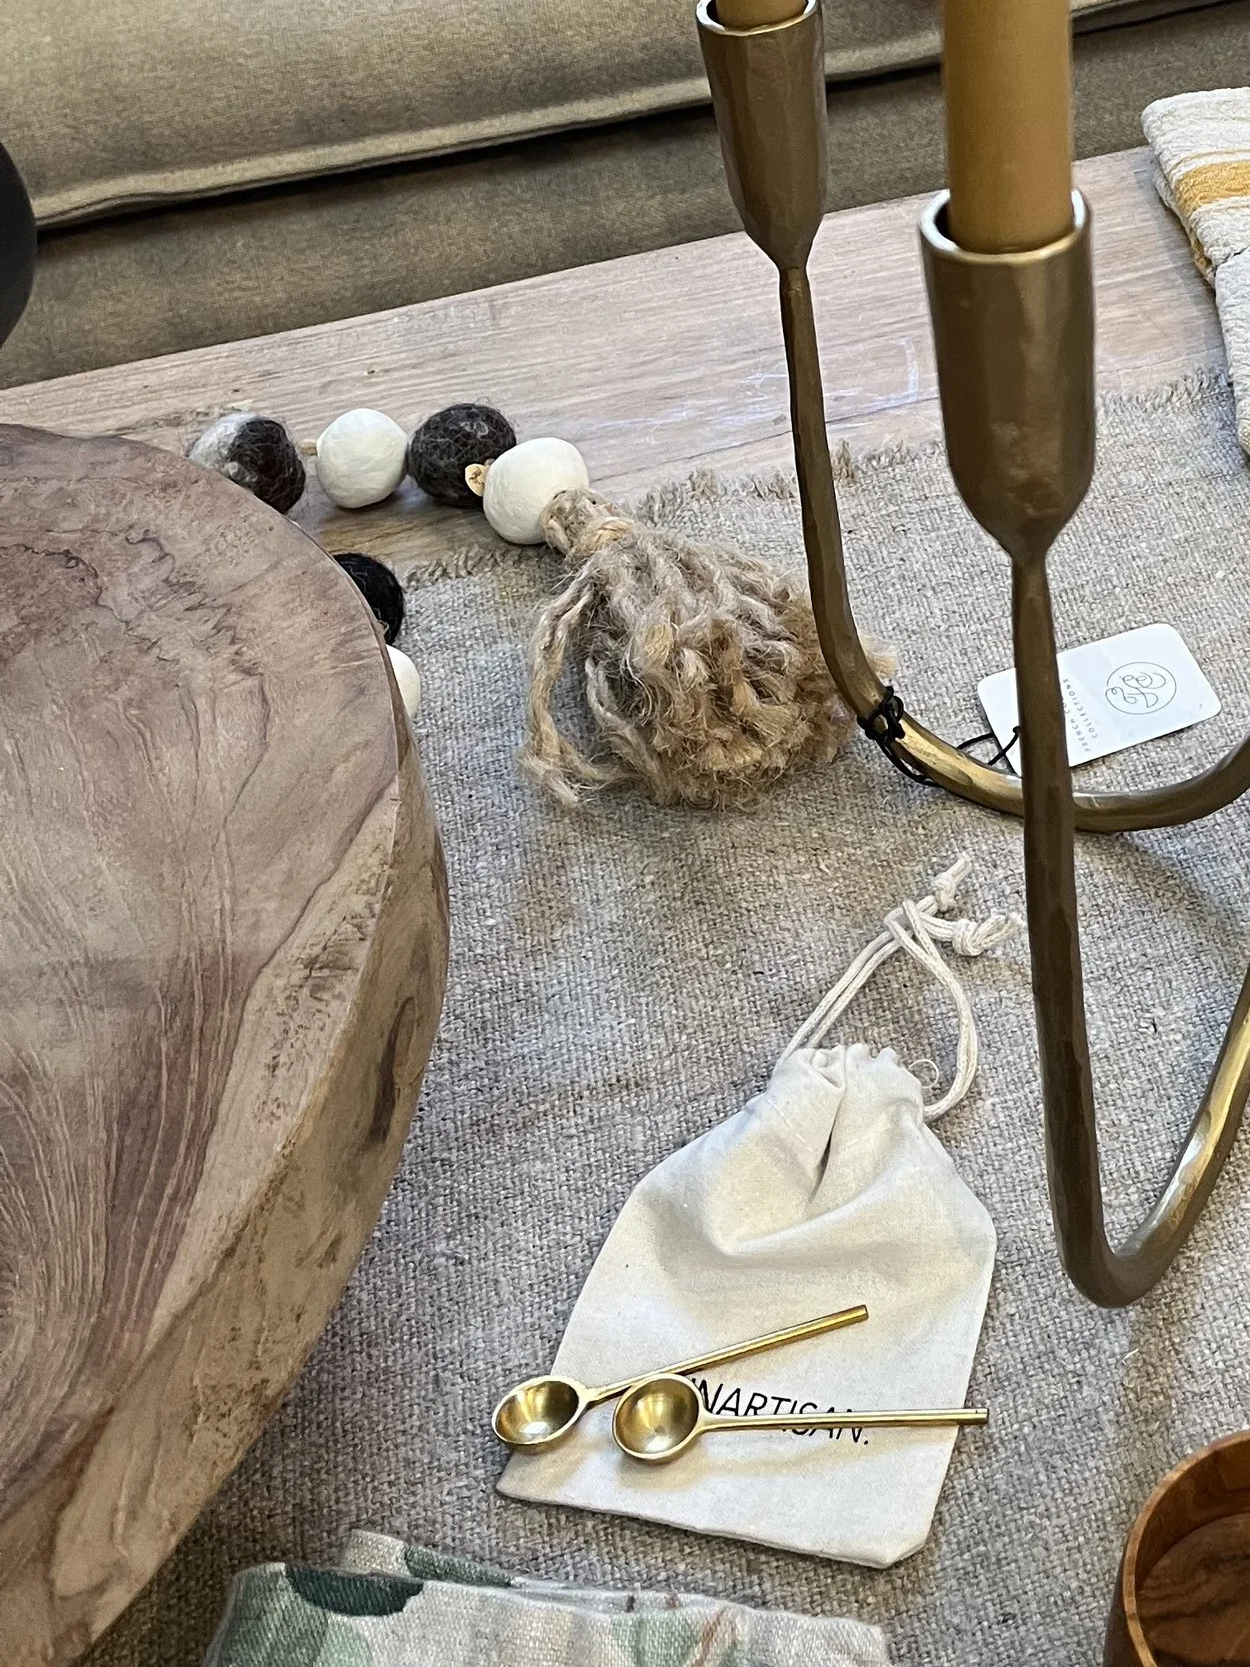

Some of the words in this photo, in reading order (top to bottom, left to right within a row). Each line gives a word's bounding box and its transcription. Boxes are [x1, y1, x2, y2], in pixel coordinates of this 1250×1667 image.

[1062, 678, 1098, 739] COLLECTIONS
[1070, 718, 1091, 752] FRENCH
[691, 1377, 869, 1445] NARTISAN.
